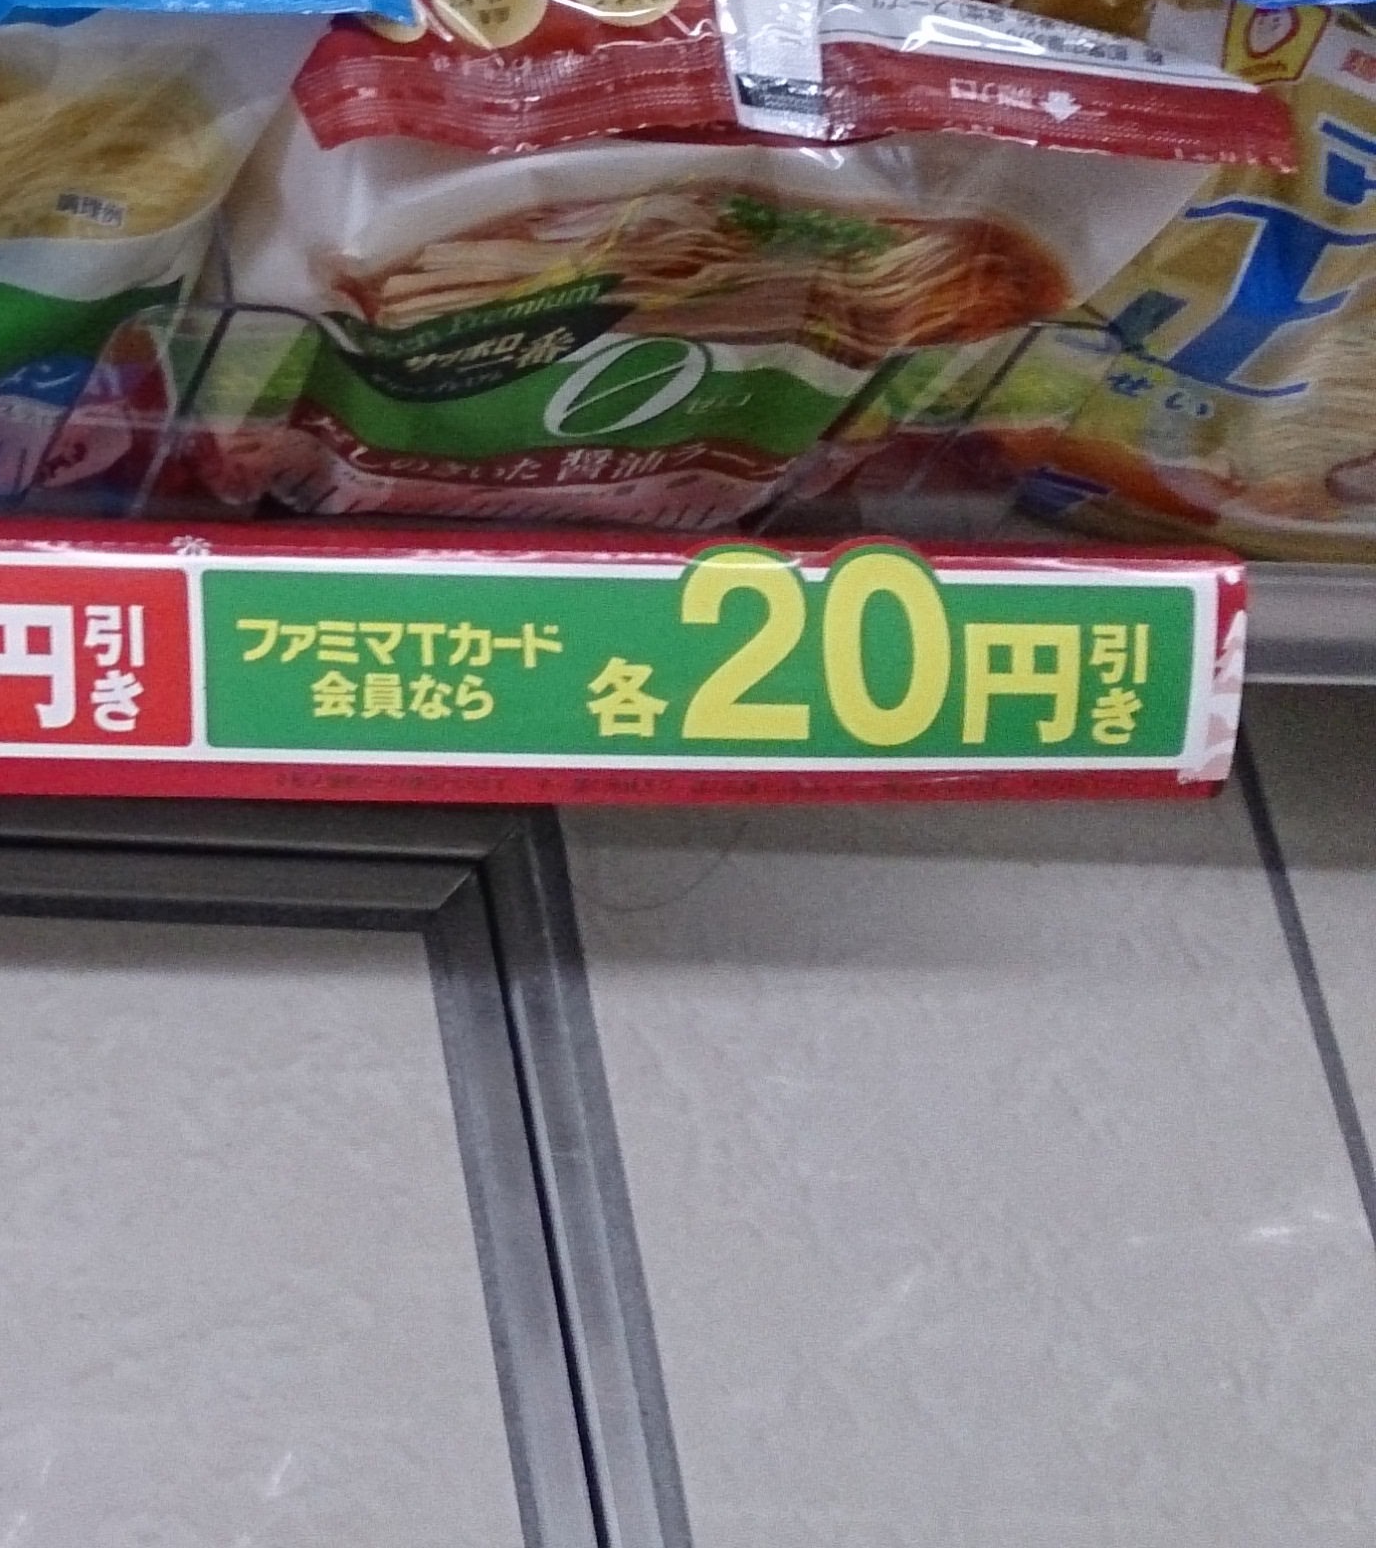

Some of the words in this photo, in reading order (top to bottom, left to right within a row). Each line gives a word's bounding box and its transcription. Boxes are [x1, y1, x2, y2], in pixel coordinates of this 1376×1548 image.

[235, 617, 563, 665] ファミマTカード
[310, 668, 495, 722] 会員なら
